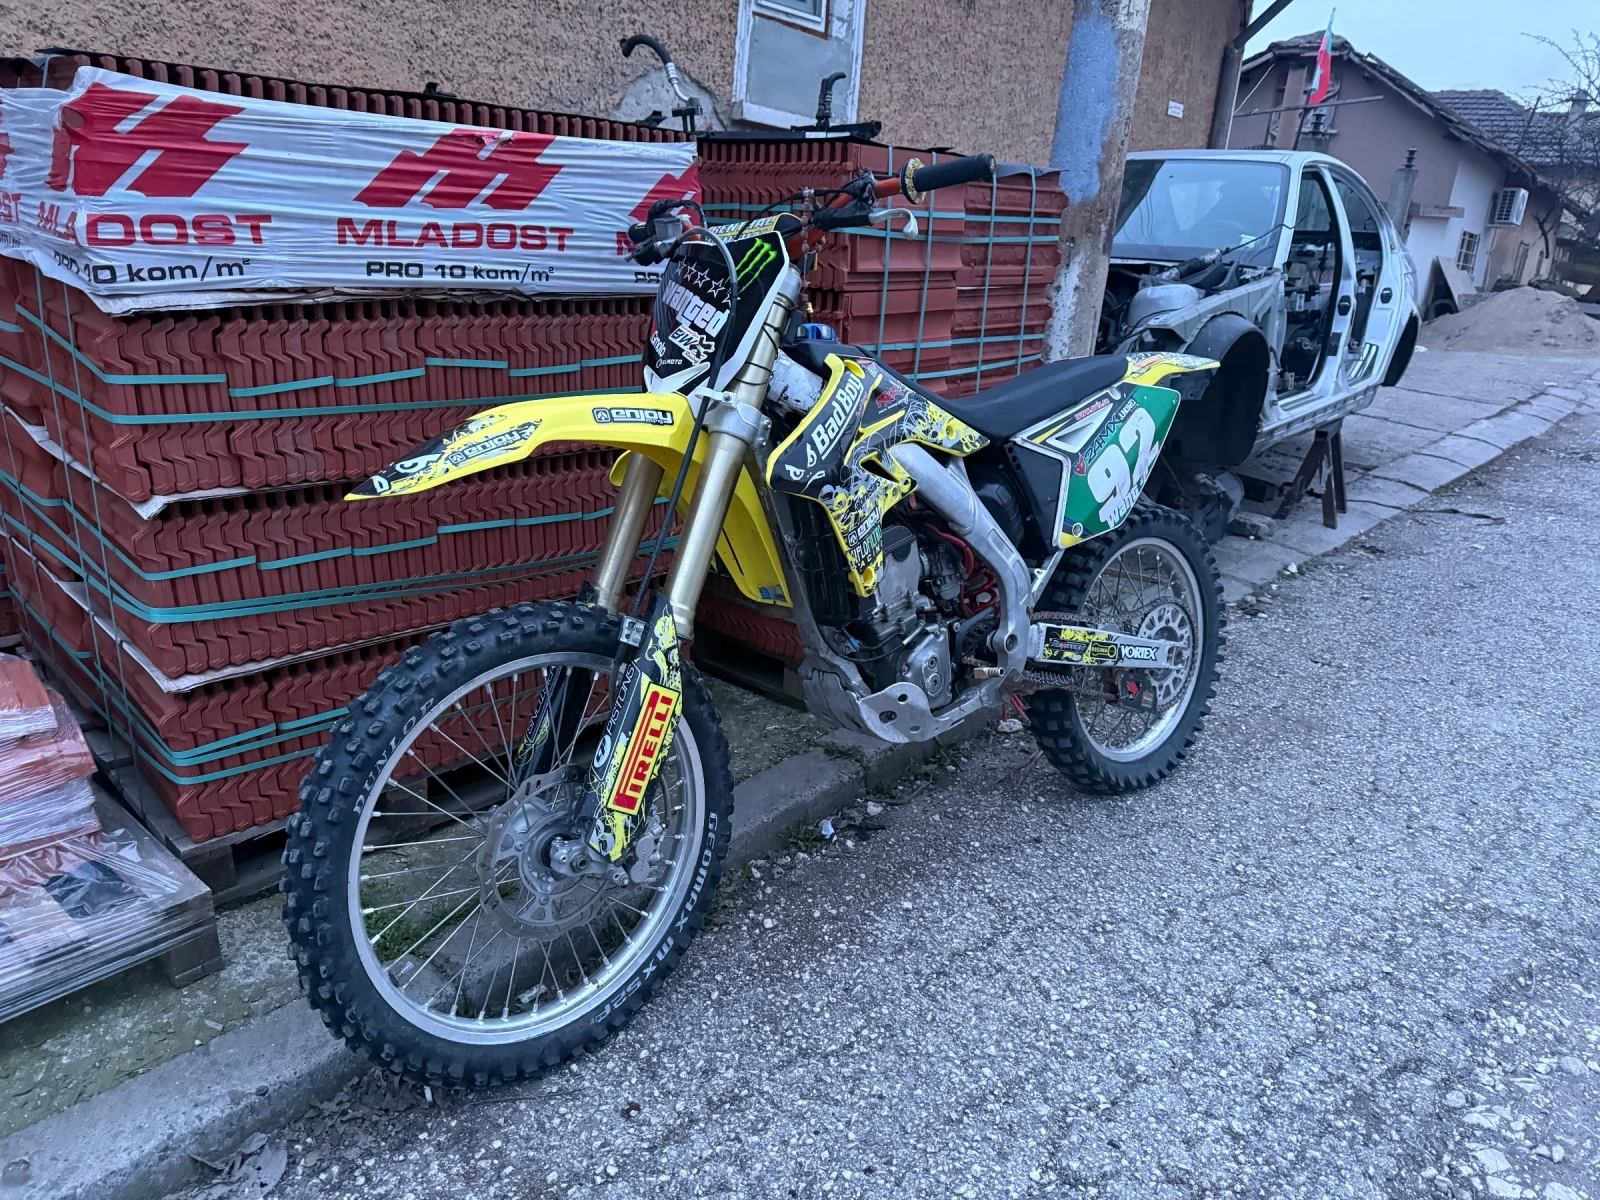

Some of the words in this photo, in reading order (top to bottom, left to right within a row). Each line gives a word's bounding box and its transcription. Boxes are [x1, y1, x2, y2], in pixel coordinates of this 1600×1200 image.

[337, 217, 574, 252] MLADOST
[84, 263, 118, 284] 10
[366, 261, 423, 279] PRO
[434, 264, 467, 280] 10
[611, 408, 674, 425] enjoy
[464, 429, 521, 459] enjoy
[1083, 412, 1121, 465] 24MX
[1087, 407, 1160, 523] 92
[857, 506, 880, 540] enjoy
[1120, 645, 1160, 661] VORTEX
[607, 666, 635, 736] PISTONS
[353, 697, 435, 815] DUNLOP
[612, 690, 674, 811] PIRELLI
[675, 811, 718, 933] GEOMAX
